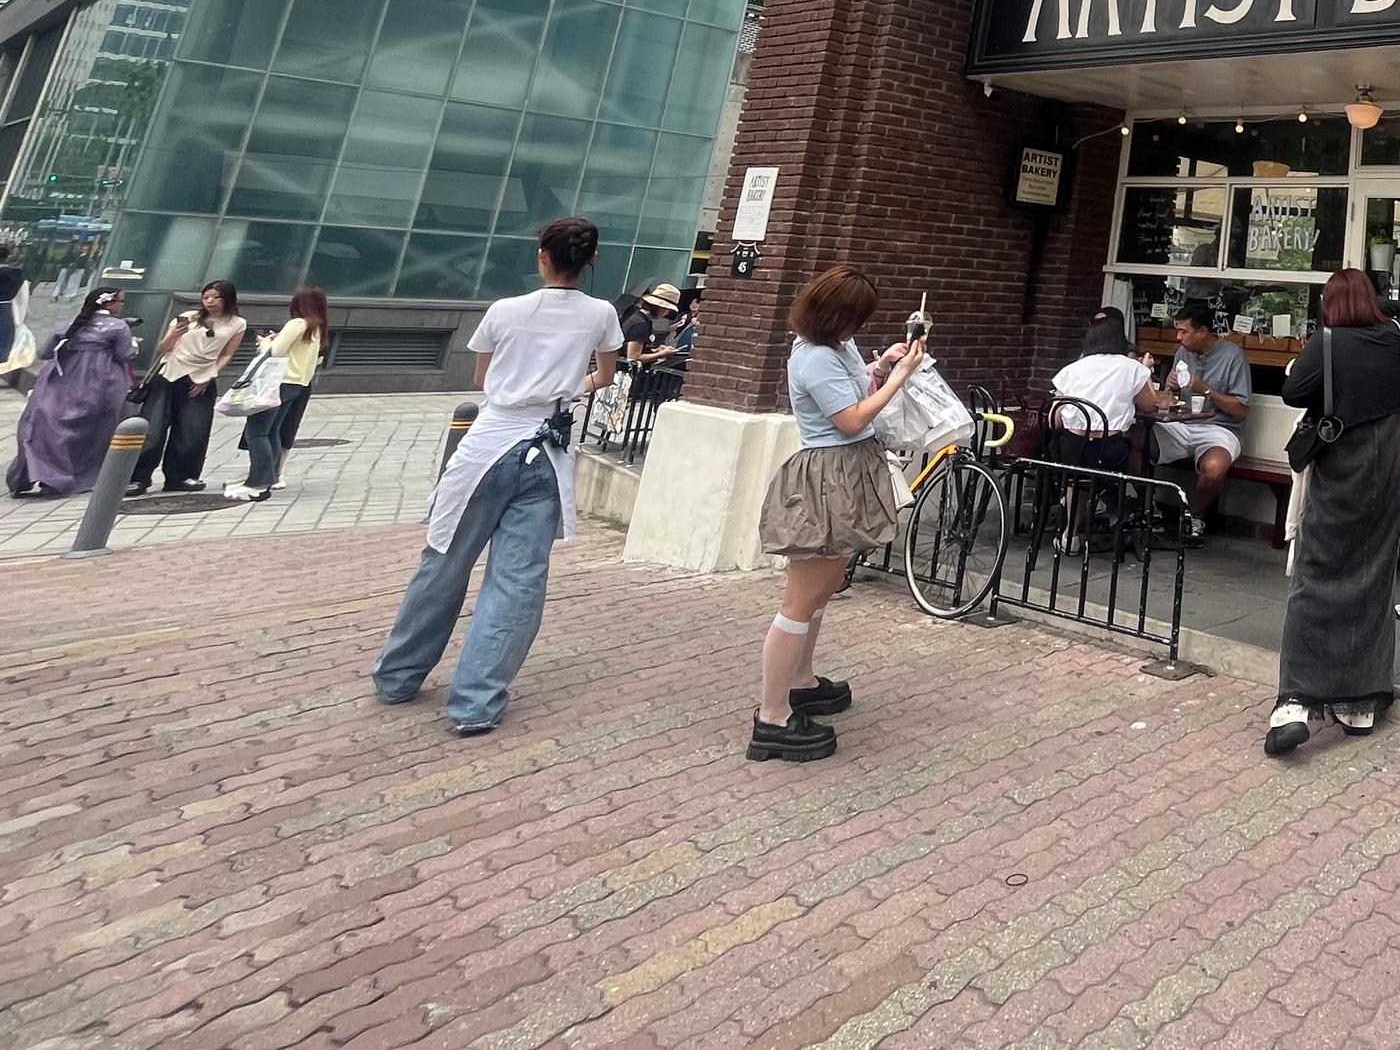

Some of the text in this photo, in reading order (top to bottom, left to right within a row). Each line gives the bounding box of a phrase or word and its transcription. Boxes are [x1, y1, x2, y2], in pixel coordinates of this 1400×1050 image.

[1023, 151, 1060, 167] ARTIST
[1022, 164, 1058, 179] BAKERY
[1249, 195, 1316, 222] ARTIST
